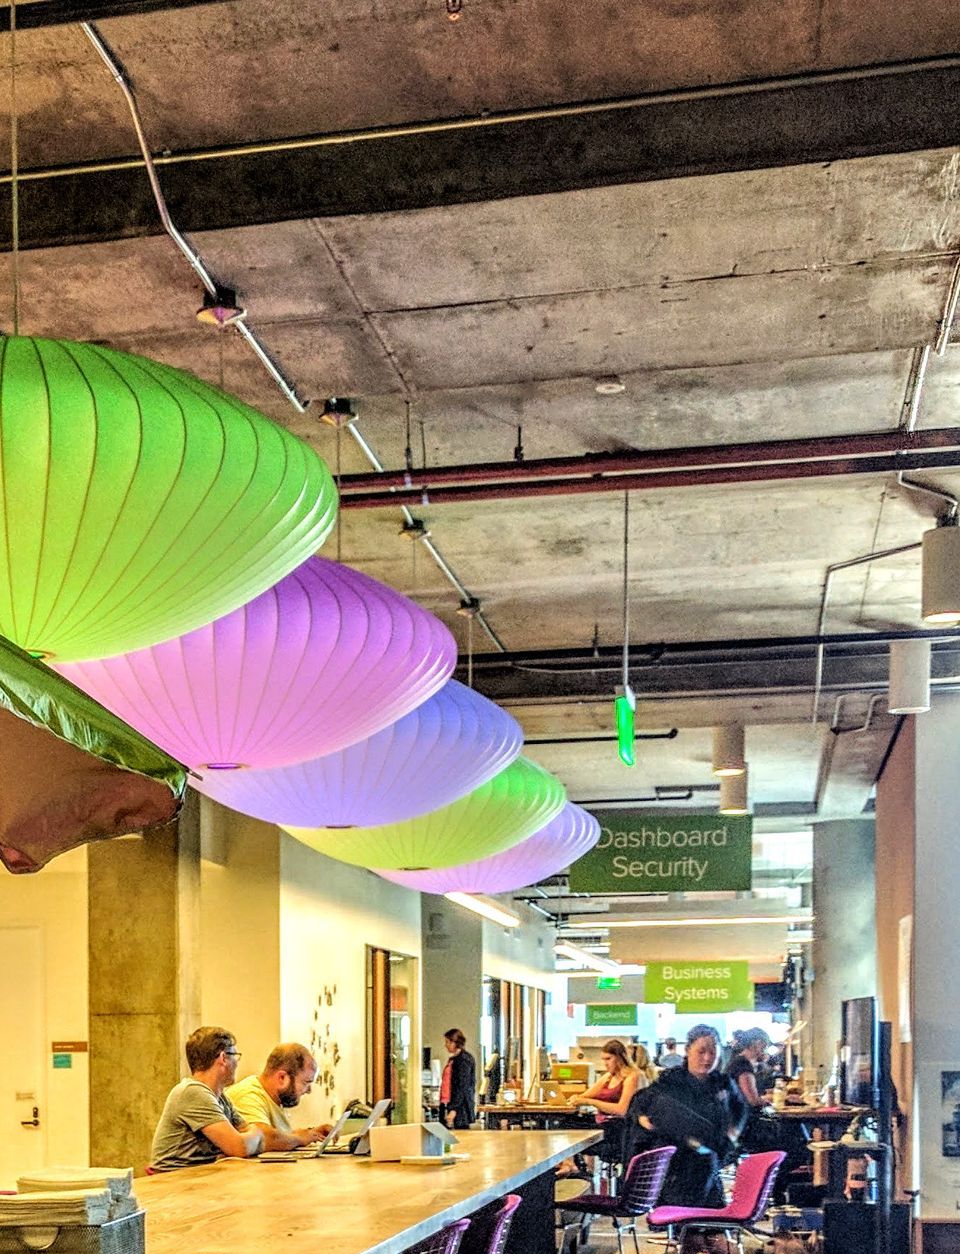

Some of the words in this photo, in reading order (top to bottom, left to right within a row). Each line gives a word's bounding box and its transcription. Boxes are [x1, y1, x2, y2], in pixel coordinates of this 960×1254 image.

[596, 826, 728, 848] Dashboard
[612, 856, 709, 881] Security
[662, 966, 732, 979] Business
[664, 986, 729, 1003] Systems
